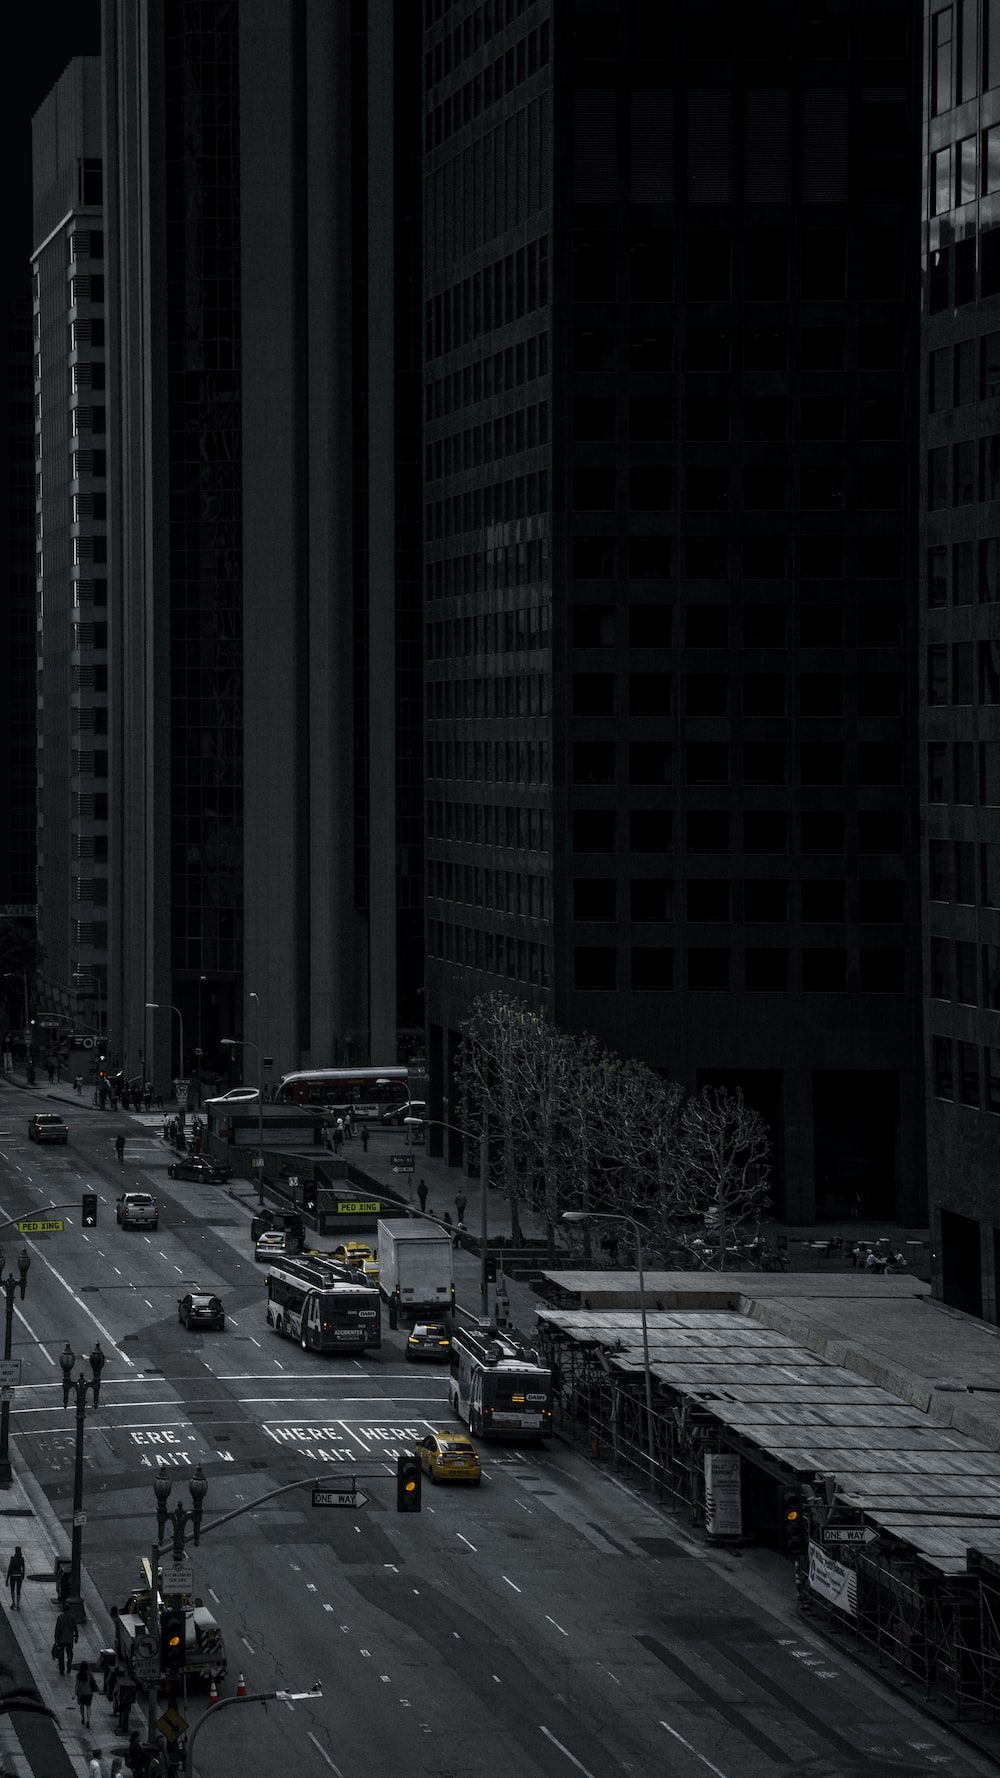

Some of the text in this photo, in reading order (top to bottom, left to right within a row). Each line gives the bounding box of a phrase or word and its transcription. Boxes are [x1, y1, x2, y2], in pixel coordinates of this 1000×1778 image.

[360, 1203, 377, 1211] XING
[22, 1222, 60, 1231] PED XING
[129, 1431, 181, 1445] ERE
[276, 1428, 344, 1440] HERE
[359, 1428, 425, 1440] HERE
[383, 1449, 416, 1462] WA
[315, 1494, 356, 1504] ONE WAY
[824, 1530, 865, 1540] ONE WAY
